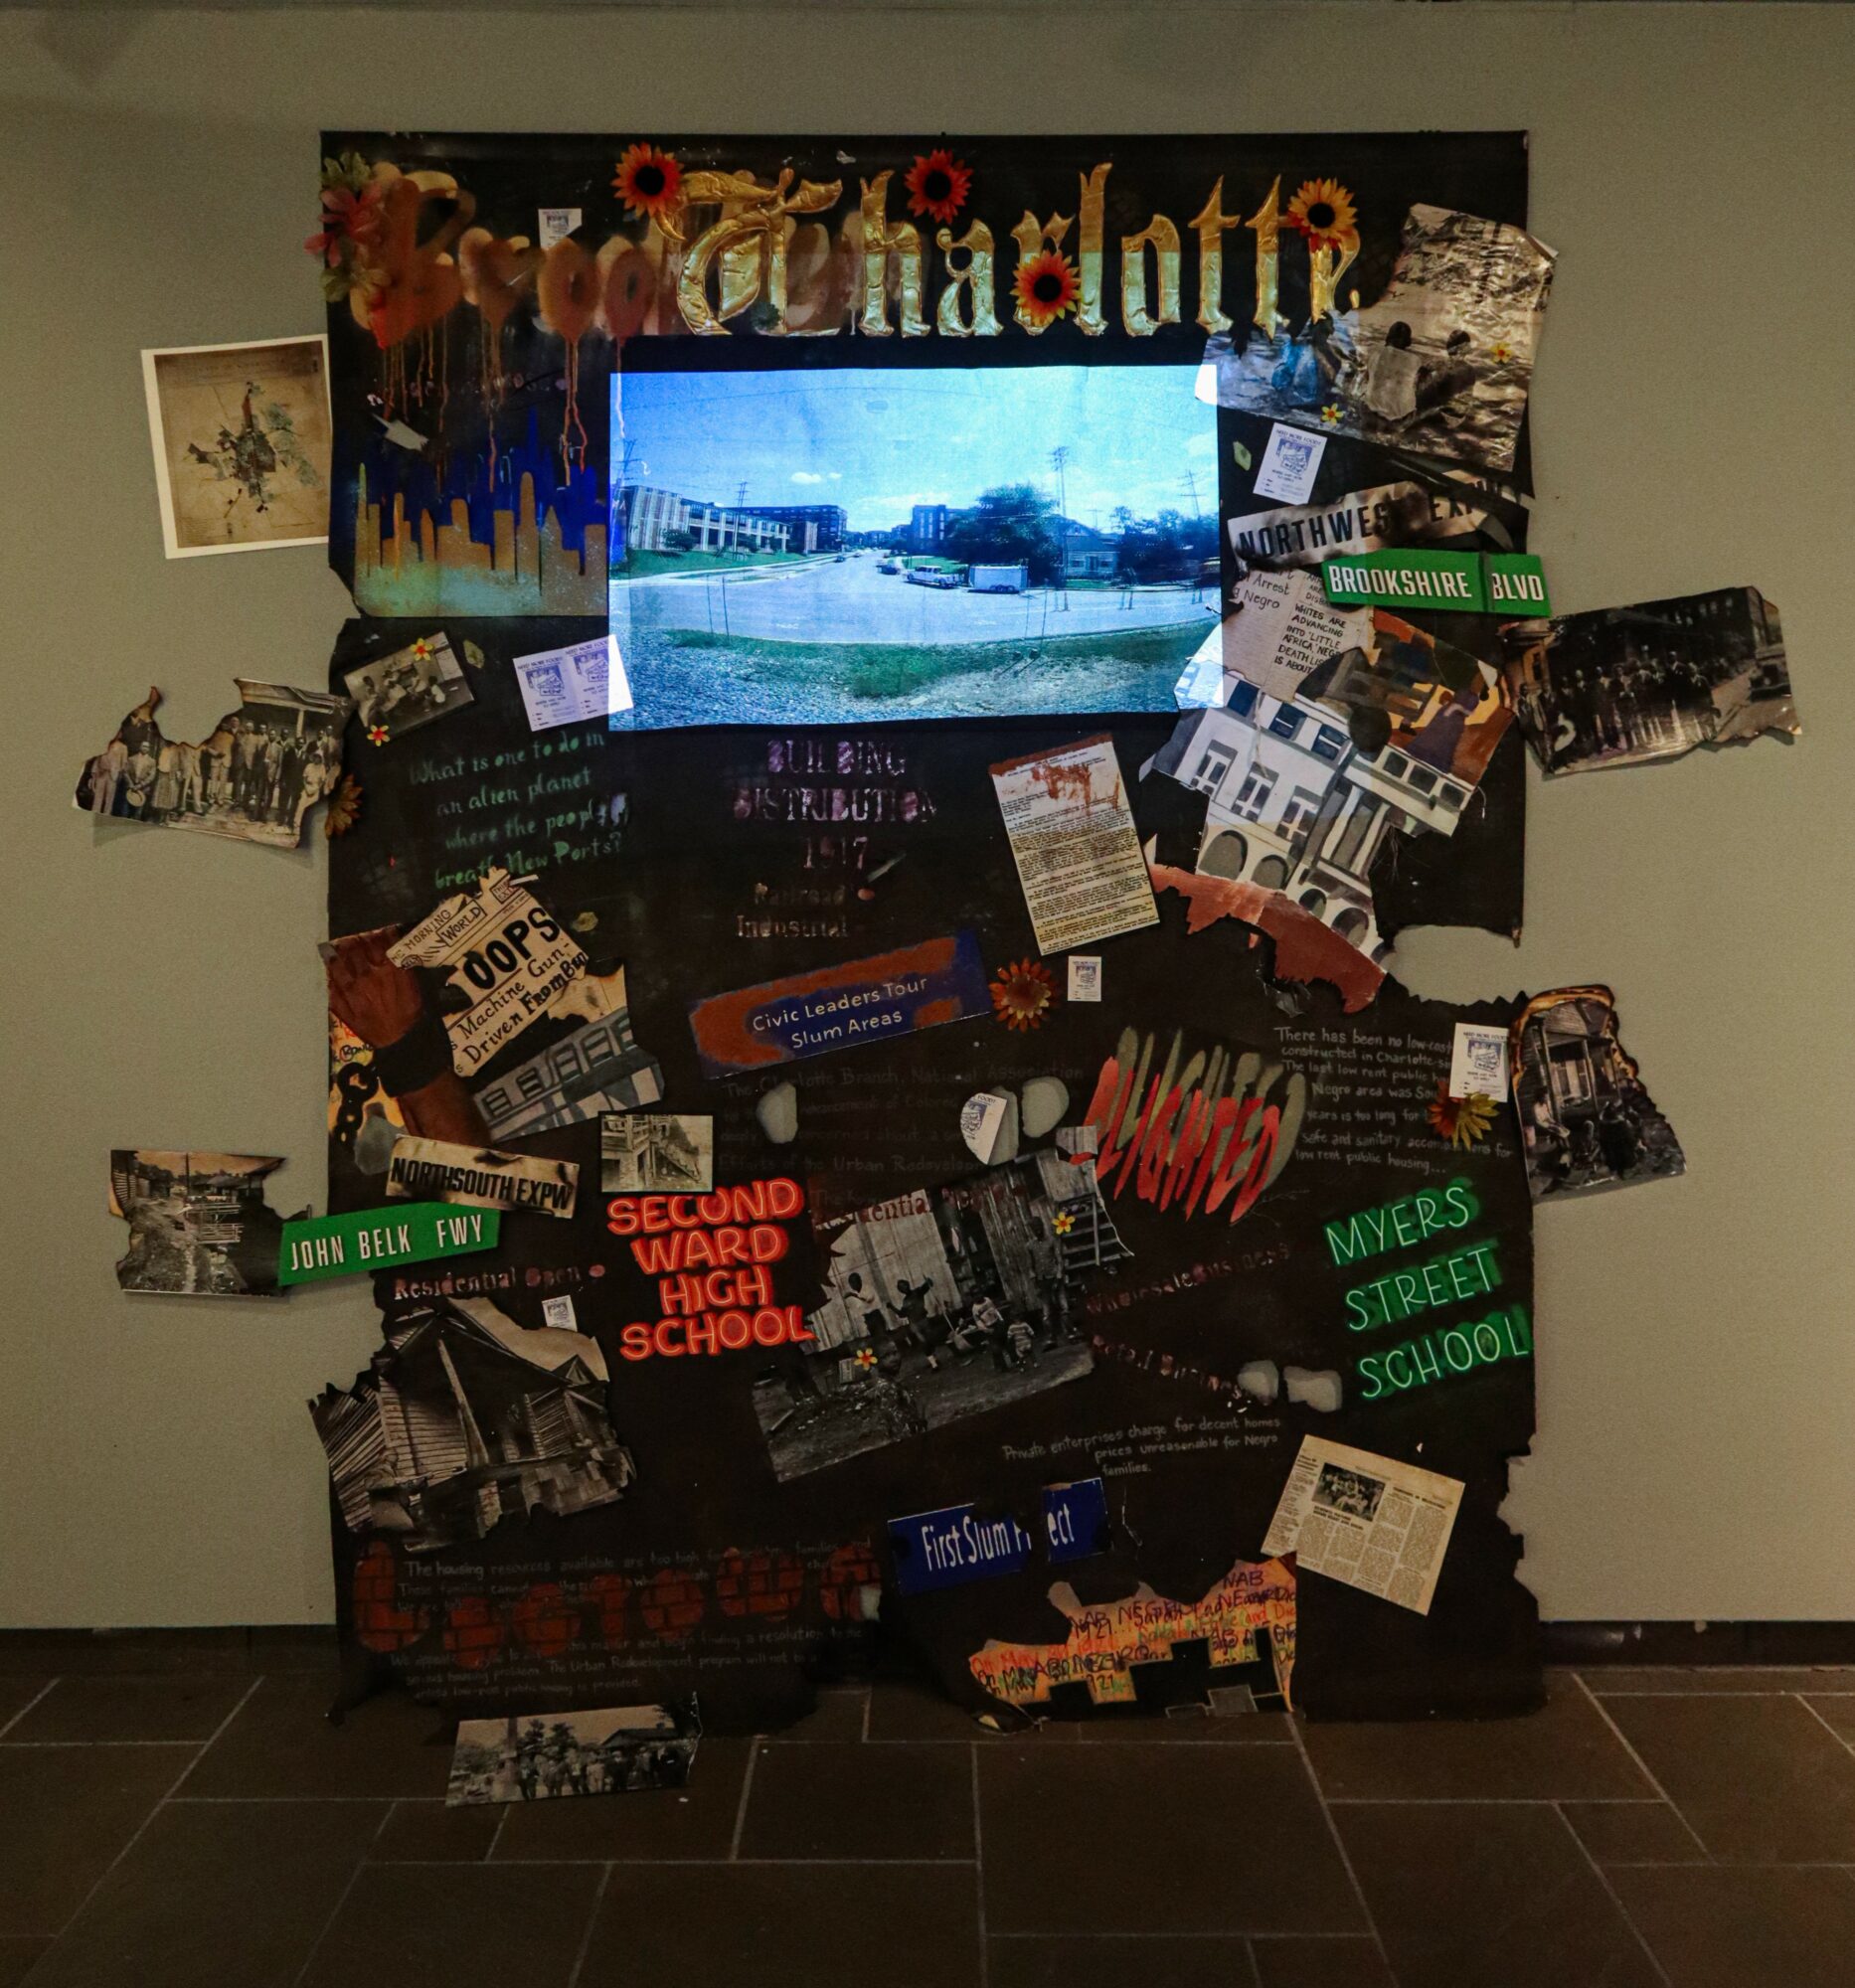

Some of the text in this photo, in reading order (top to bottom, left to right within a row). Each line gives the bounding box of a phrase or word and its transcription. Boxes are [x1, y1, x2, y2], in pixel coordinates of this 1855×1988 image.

[1240, 501, 1392, 558] NORTHWES
[1244, 589, 1279, 609] Negro
[1254, 574, 1290, 595] Arrest
[1328, 565, 1472, 598] BROOKSHIRE
[1492, 572, 1544, 601] BLVD
[1291, 614, 1343, 637] ADVANCING
[1294, 603, 1346, 629] WHITES ARE
[1274, 655, 1313, 674] IS ABOUT
[1277, 644, 1309, 663] DEATH
[409, 753, 465, 785] What
[472, 756, 489, 772] is
[494, 748, 526, 768] one
[532, 739, 553, 759] to
[558, 730, 581, 753] do
[436, 764, 590, 817] an alien planet
[445, 826, 497, 850] where
[504, 813, 537, 838] the
[505, 849, 548, 876] New
[553, 832, 621, 866] Ports?
[405, 907, 482, 950] MORNING WORLD
[463, 908, 560, 989] OOPS
[457, 982, 525, 1040] Machine
[753, 978, 928, 1032] Civic Leaders Tour
[462, 1012, 524, 1065] Driven
[791, 1010, 903, 1049] Slum Areas
[1273, 1027, 1316, 1042] There
[1322, 1028, 1347, 1042] has
[1353, 1028, 1383, 1046] been
[1388, 1036, 1403, 1047] no
[1281, 1046, 1356, 1059] constructed
[1281, 1059, 1428, 1084] The last low rent public
[1311, 1081, 1351, 1102] Negro
[1355, 1087, 1383, 1096] area
[1389, 1088, 1413, 1098] was
[1306, 1108, 1419, 1126] years is too long for
[1295, 1149, 1314, 1161] low
[1317, 1150, 1341, 1161] rent
[1346, 1151, 1382, 1166] public
[1301, 1129, 1327, 1143] safe
[1331, 1131, 1351, 1145] and
[1356, 1129, 1402, 1148] sanitary
[516, 1178, 573, 1211] EXPW
[606, 1177, 804, 1236] SECOND
[290, 1214, 482, 1271] JOHN BELK FWY
[1325, 1183, 1473, 1265] MYERS
[630, 1224, 788, 1275] WARD
[394, 1266, 517, 1300] Residential
[659, 1264, 773, 1315] HIGH
[1346, 1242, 1497, 1331] STREET
[620, 1304, 816, 1362] SCHOOL
[1358, 1310, 1532, 1398] SCHOOL
[1001, 1415, 1280, 1460] Private enterprises charge for decent homes
[1094, 1434, 1278, 1464] prices unreasonable for Negro
[921, 1525, 964, 1573] First
[962, 1515, 1011, 1564] Slum
[403, 1561, 432, 1577] The
[435, 1560, 485, 1581] housing
